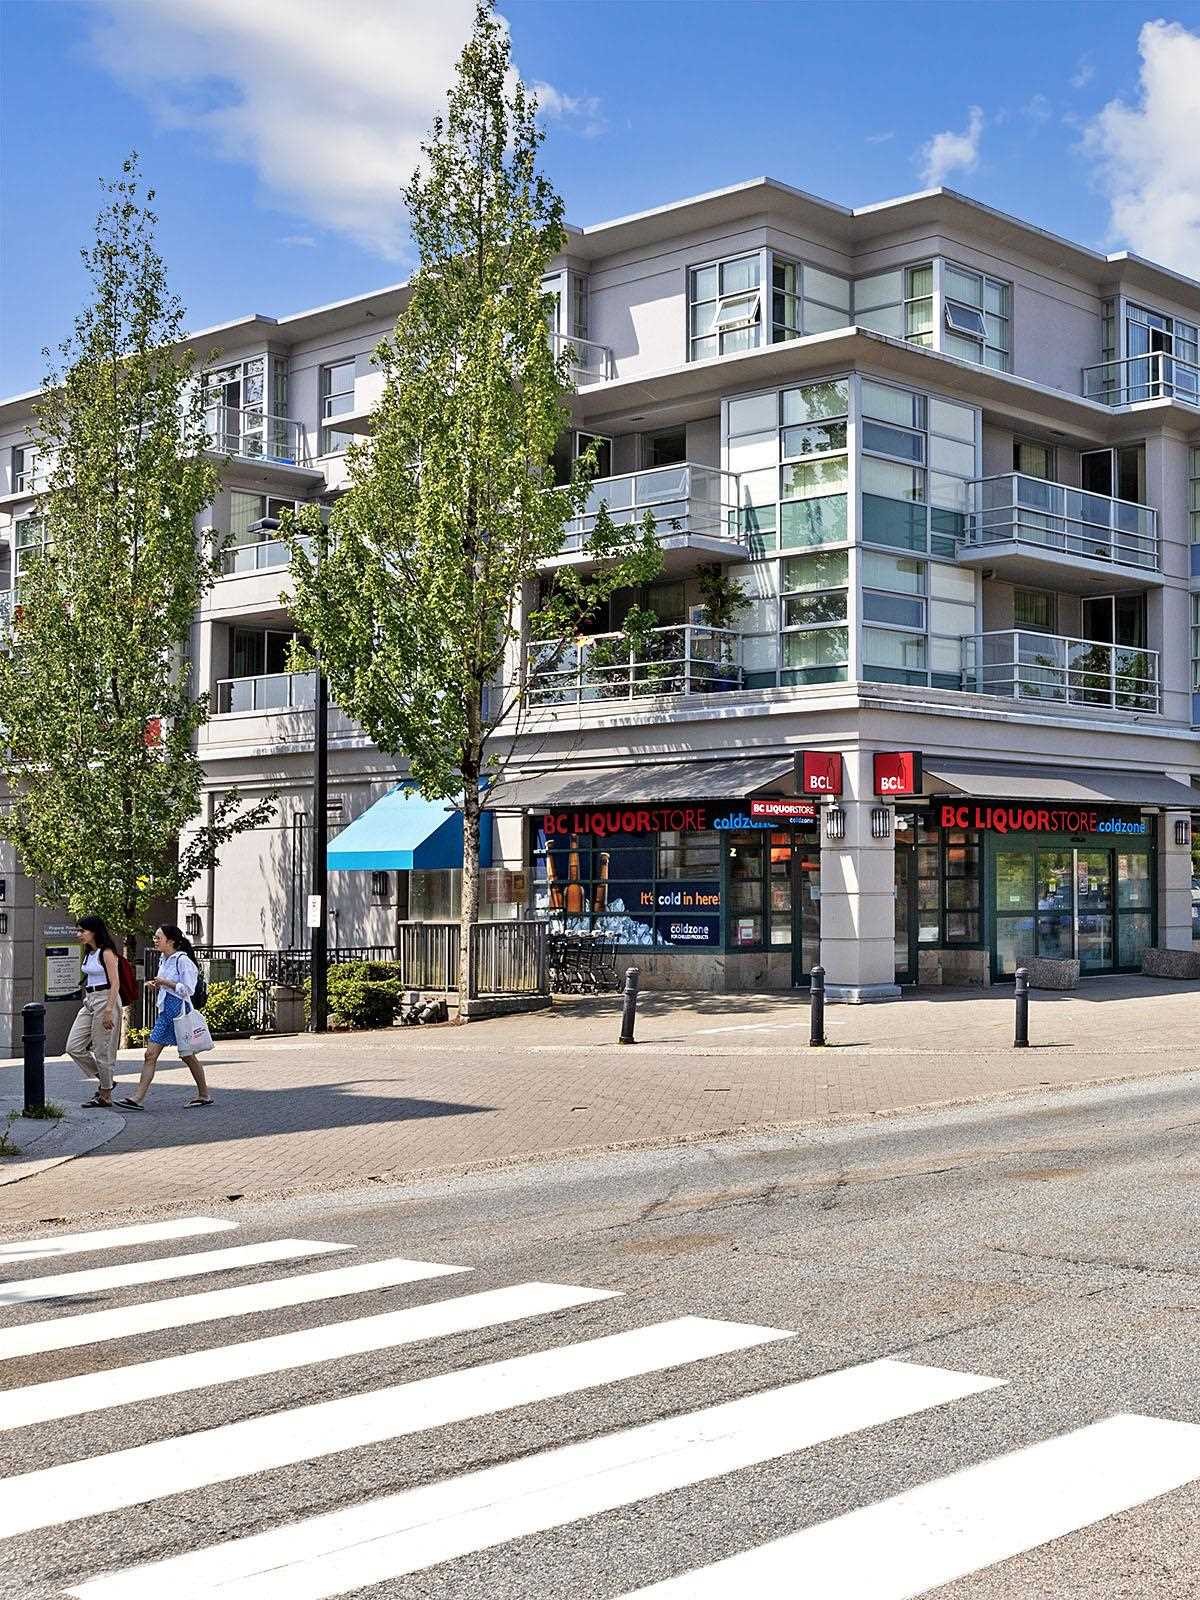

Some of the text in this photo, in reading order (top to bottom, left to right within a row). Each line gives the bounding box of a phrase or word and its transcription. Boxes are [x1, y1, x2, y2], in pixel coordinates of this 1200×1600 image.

[810, 775, 832, 789] BCL
[880, 776, 904, 790] BCL
[753, 804, 814, 815] BC LIQUORSTORE
[543, 809, 706, 837] BC LIQUORSTORE
[941, 805, 1097, 833] BC LIQUORSTORE
[1099, 817, 1146, 833] coldzone
[640, 891, 655, 905] It's
[658, 891, 681, 905] cold
[683, 891, 693, 905] in
[670, 923, 709, 934] coldzone
